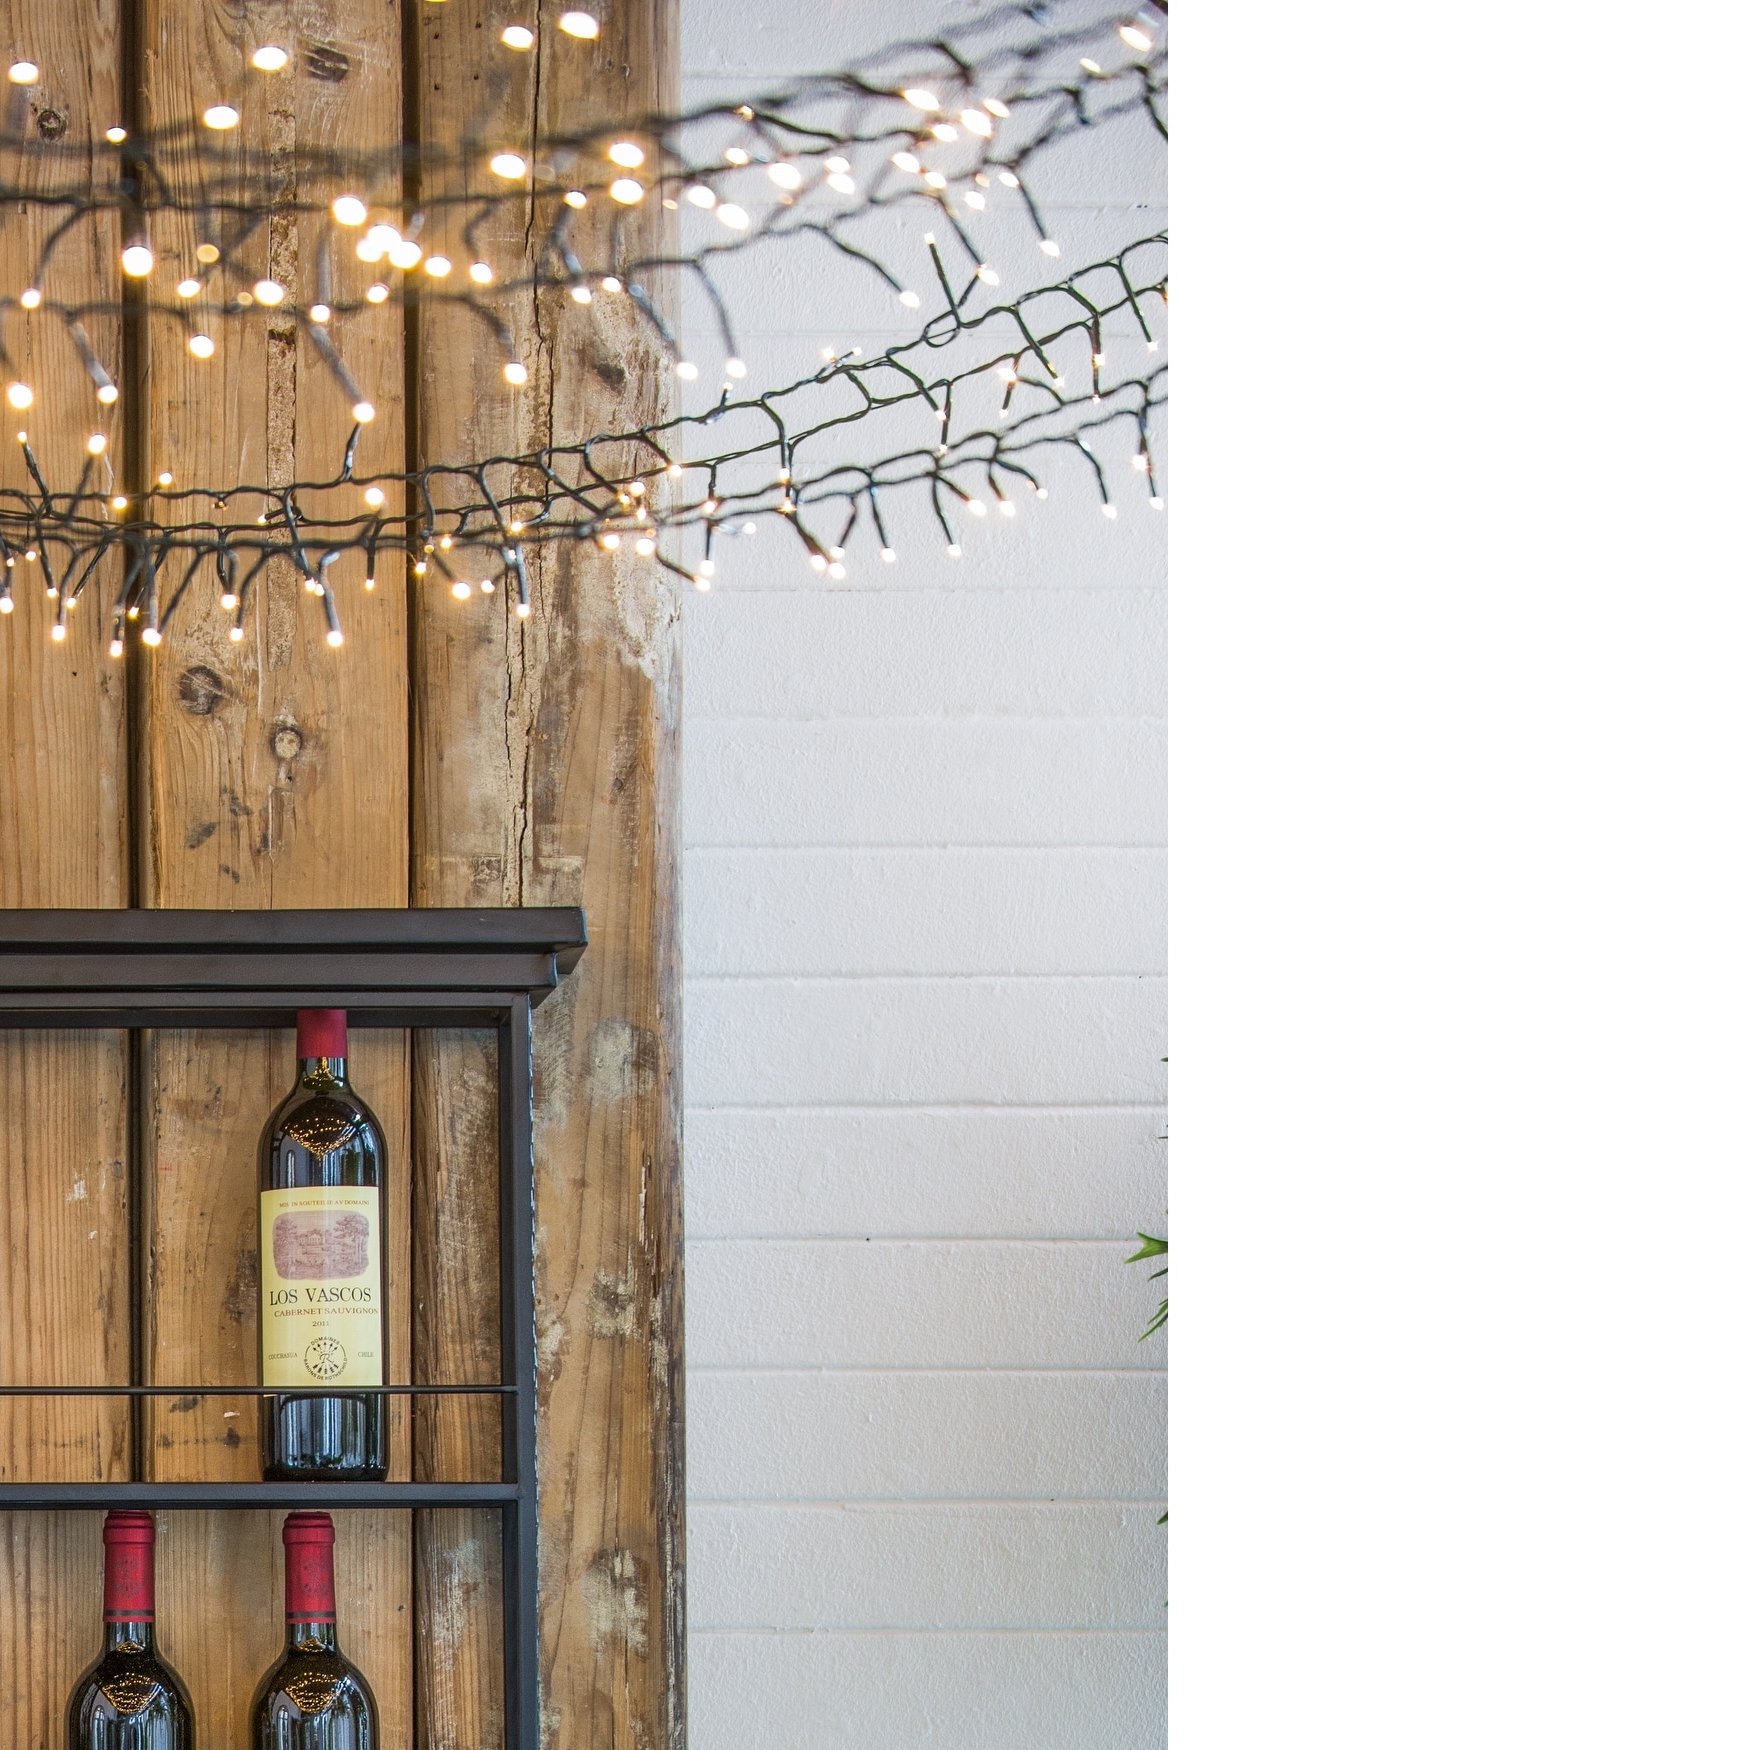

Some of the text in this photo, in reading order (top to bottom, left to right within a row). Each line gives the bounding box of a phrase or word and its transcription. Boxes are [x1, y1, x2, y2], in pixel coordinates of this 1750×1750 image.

[269, 1286, 372, 1306] LOS VASCOS
[274, 1307, 379, 1318] CABERNET SAUVIGNON
